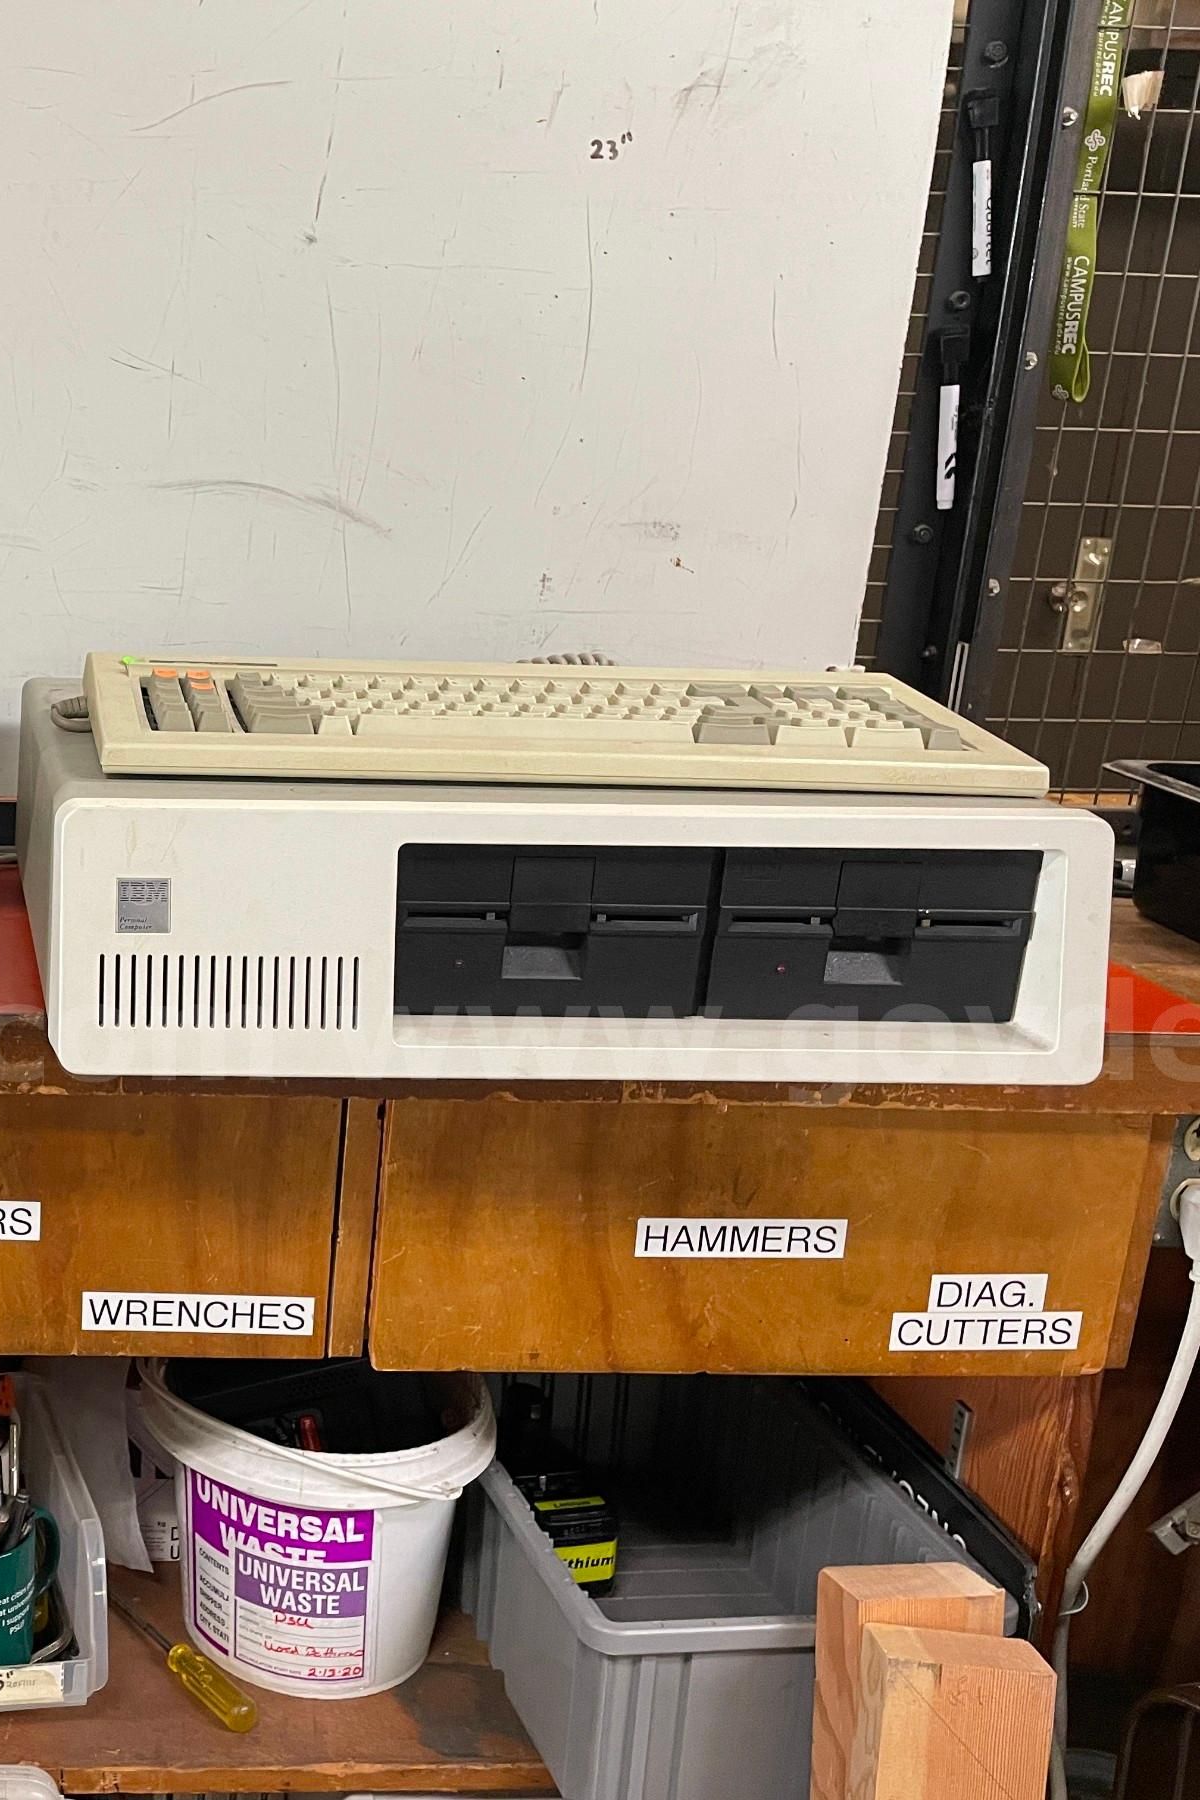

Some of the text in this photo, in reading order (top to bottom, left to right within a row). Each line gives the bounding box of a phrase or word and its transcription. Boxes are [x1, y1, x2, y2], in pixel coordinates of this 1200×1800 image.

[1099, 0, 1125, 97] AMPUSREC
[589, 131, 633, 161] 23"
[1060, 255, 1090, 355] CAMPUSREC
[119, 881, 168, 902] IBM
[642, 1224, 838, 1255] HAMMERS
[936, 1279, 1035, 1309] DIAG.
[88, 1297, 306, 1332] WRENCHES
[897, 1317, 1072, 1347] CUTTERS
[195, 1471, 365, 1545] UNIVERSAL
[237, 1552, 366, 1594] UNIVERSAL
[259, 1583, 340, 1616] WASTE
